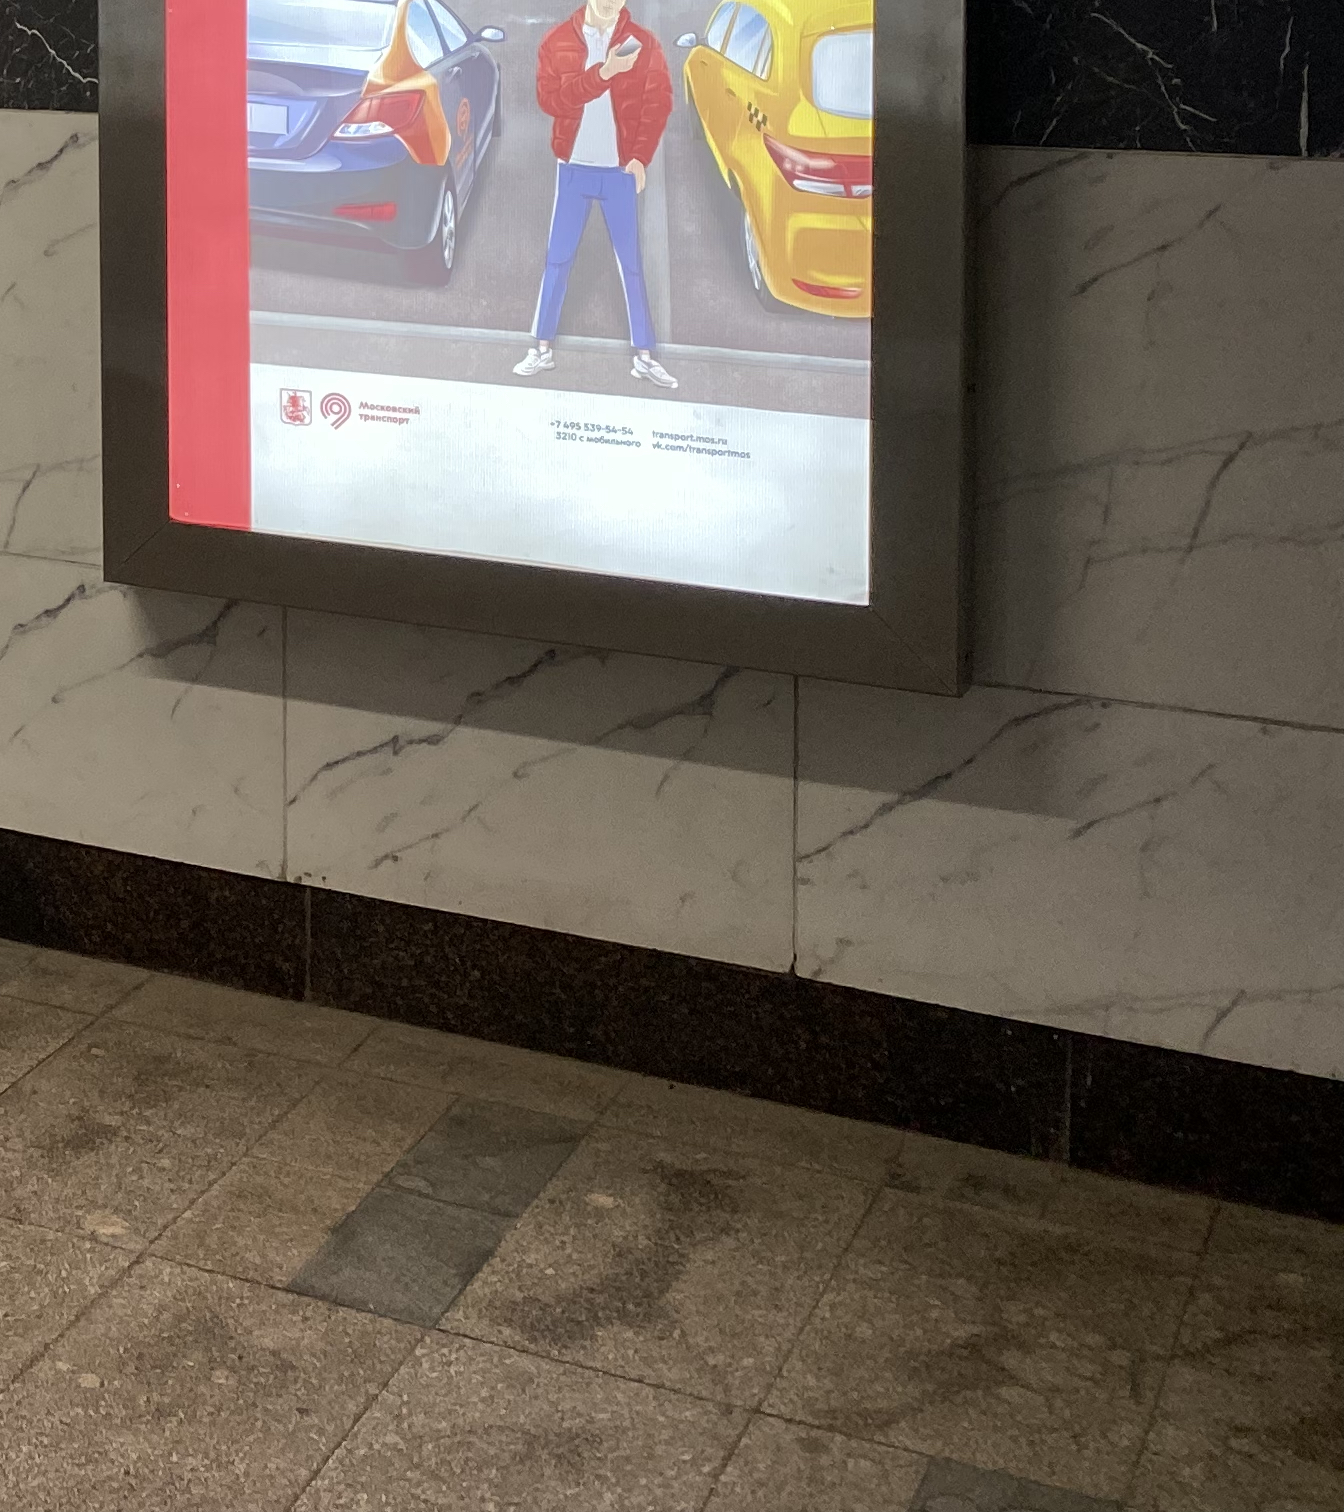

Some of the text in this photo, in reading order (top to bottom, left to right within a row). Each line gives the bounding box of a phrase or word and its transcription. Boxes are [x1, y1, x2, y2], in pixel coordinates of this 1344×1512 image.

[358, 400, 421, 415] Московский
[358, 412, 410, 426] транспорт
[550, 420, 634, 436] +7 495 539-54-54
[555, 431, 642, 448] 3210 с мобильного
[651, 429, 728, 446] transport.mos.ru
[651, 441, 751, 459] vk.com/transportmos
